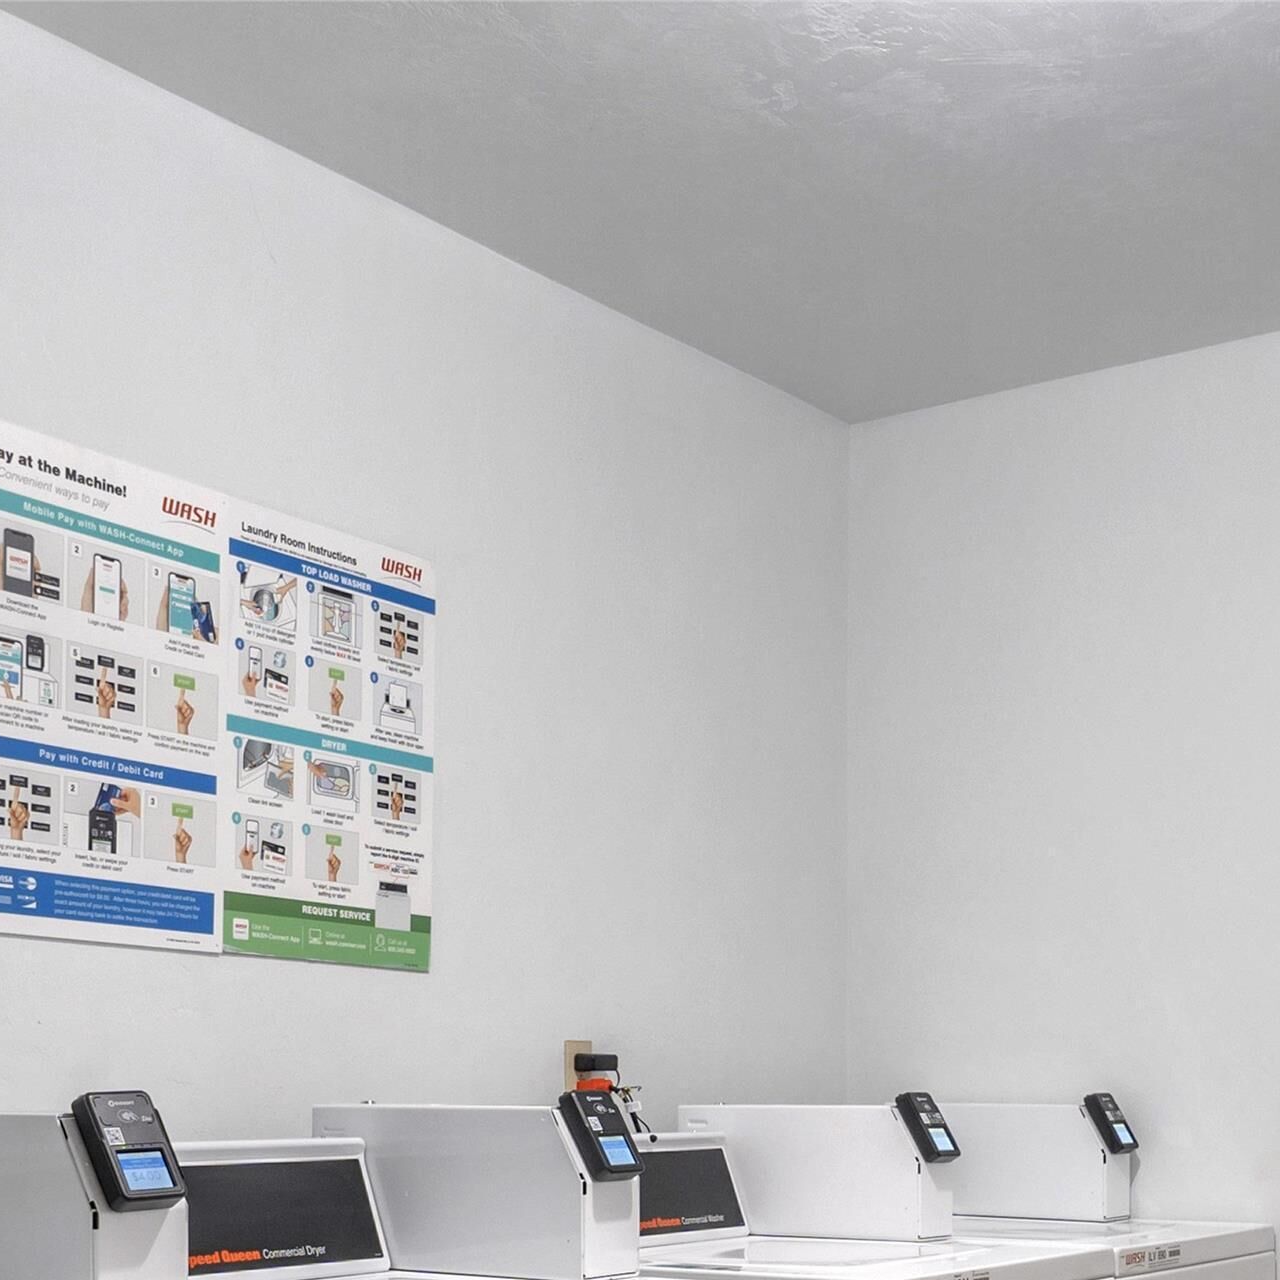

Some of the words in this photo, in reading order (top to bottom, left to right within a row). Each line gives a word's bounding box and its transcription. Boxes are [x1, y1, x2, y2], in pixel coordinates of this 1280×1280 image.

[19, 455, 33, 468] at
[38, 459, 61, 476] the
[65, 467, 127, 498] Machine!
[55, 487, 78, 500] ways
[82, 492, 90, 504] to
[92, 498, 111, 511] pay
[162, 496, 216, 528] WASH
[24, 502, 55, 518] Mobile
[58, 512, 74, 525] Pay
[77, 518, 96, 531] with
[99, 524, 164, 551] WASH-Connect
[167, 545, 184, 557] App
[74, 545, 79, 553] 2
[241, 521, 278, 543] Laundry
[280, 533, 305, 550] Room
[308, 542, 357, 566] Instructions
[301, 564, 317, 576] TOP
[319, 568, 339, 582] LOAD
[341, 575, 372, 592] WASHER
[381, 557, 422, 582] WASH
[39, 748, 57, 763] Pay
[59, 751, 79, 764] with
[81, 756, 110, 771] Credit
[111, 761, 116, 771] /
[117, 762, 141, 777] Debit
[143, 766, 164, 780] Card
[70, 784, 75, 792] 2
[302, 904, 338, 917] REQUEST
[340, 906, 371, 921] SERVICE
[189, 1250, 221, 1268] peed
[221, 1249, 261, 1263] Queen
[263, 1246, 305, 1259] Commercial
[306, 1245, 326, 1256] Dryer
